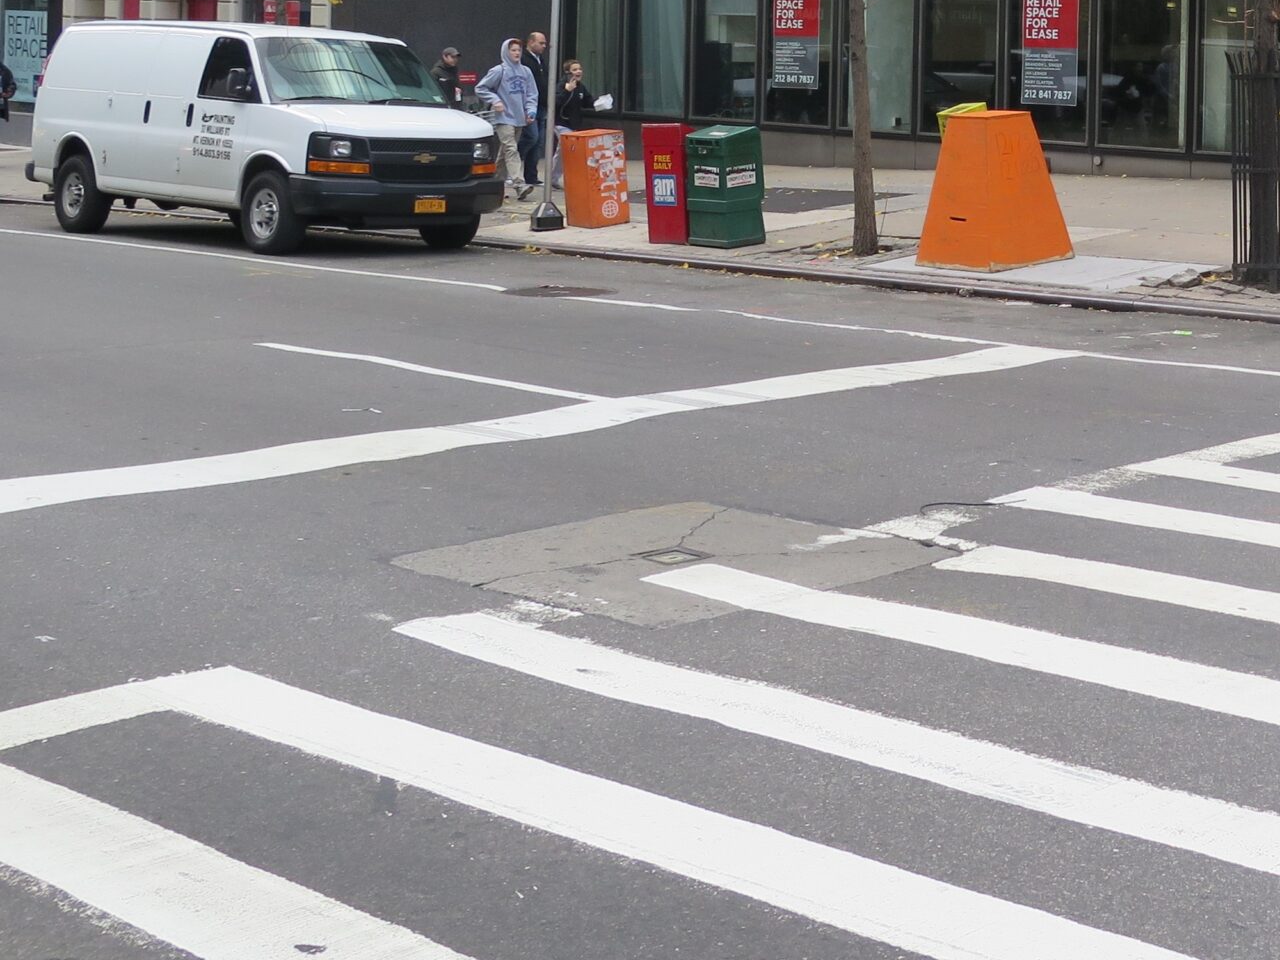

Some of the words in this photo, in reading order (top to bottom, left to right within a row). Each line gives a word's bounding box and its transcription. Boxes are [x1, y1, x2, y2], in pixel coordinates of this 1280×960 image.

[776, 0, 804, 9] SPACE
[776, 10, 795, 19] FOR
[1026, 7, 1060, 18] SPACE
[8, 15, 48, 35] RETAIL
[776, 20, 804, 29] LEASE
[1026, 18, 1048, 28] FOR
[1025, 29, 1059, 39] LEASE
[8, 38, 48, 58] SPACE
[775, 74, 785, 83] 212
[1024, 89, 1037, 98] 212
[1038, 90, 1051, 99] 841
[1053, 91, 1072, 100] 7837
[654, 154, 672, 162] FREE
[653, 162, 673, 170] DAILY
[654, 178, 675, 196] am
